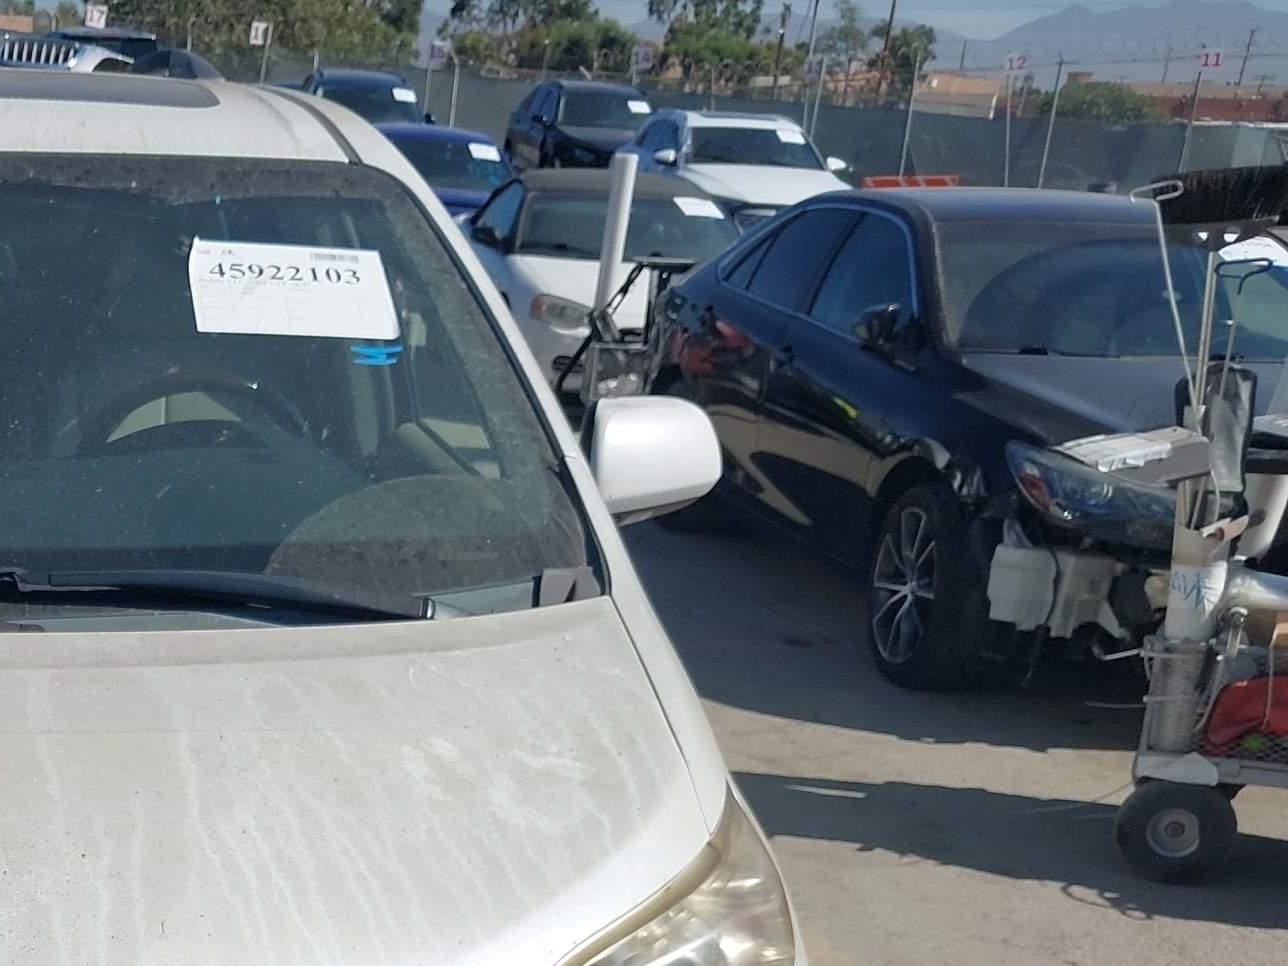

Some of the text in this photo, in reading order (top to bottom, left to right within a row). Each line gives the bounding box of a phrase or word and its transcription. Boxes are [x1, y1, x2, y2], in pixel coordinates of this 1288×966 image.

[1008, 56, 1027, 71] 12
[1201, 52, 1221, 67] 11
[209, 262, 361, 285] 45922103
